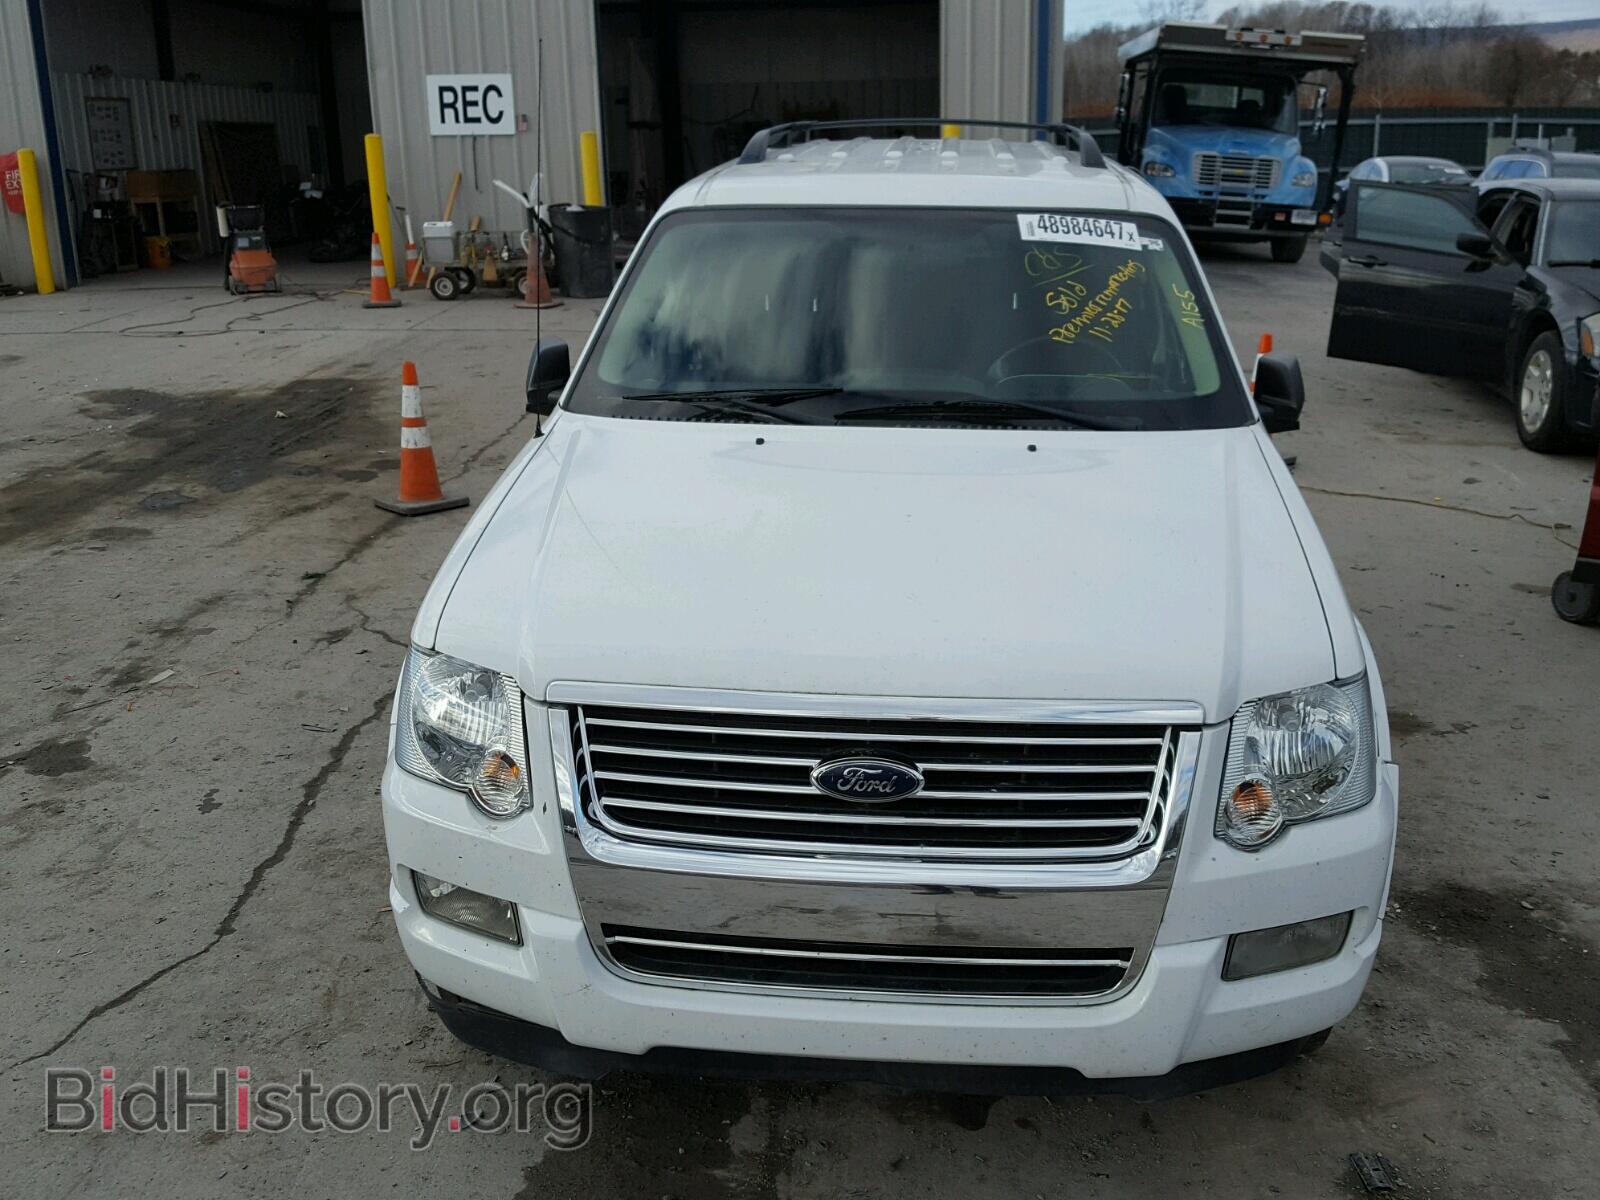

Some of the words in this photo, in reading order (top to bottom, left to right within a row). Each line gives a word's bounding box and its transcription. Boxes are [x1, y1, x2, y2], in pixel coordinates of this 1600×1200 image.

[438, 84, 504, 124] REC
[1037, 214, 1123, 241] 48984647
[837, 767, 898, 793] Ford
